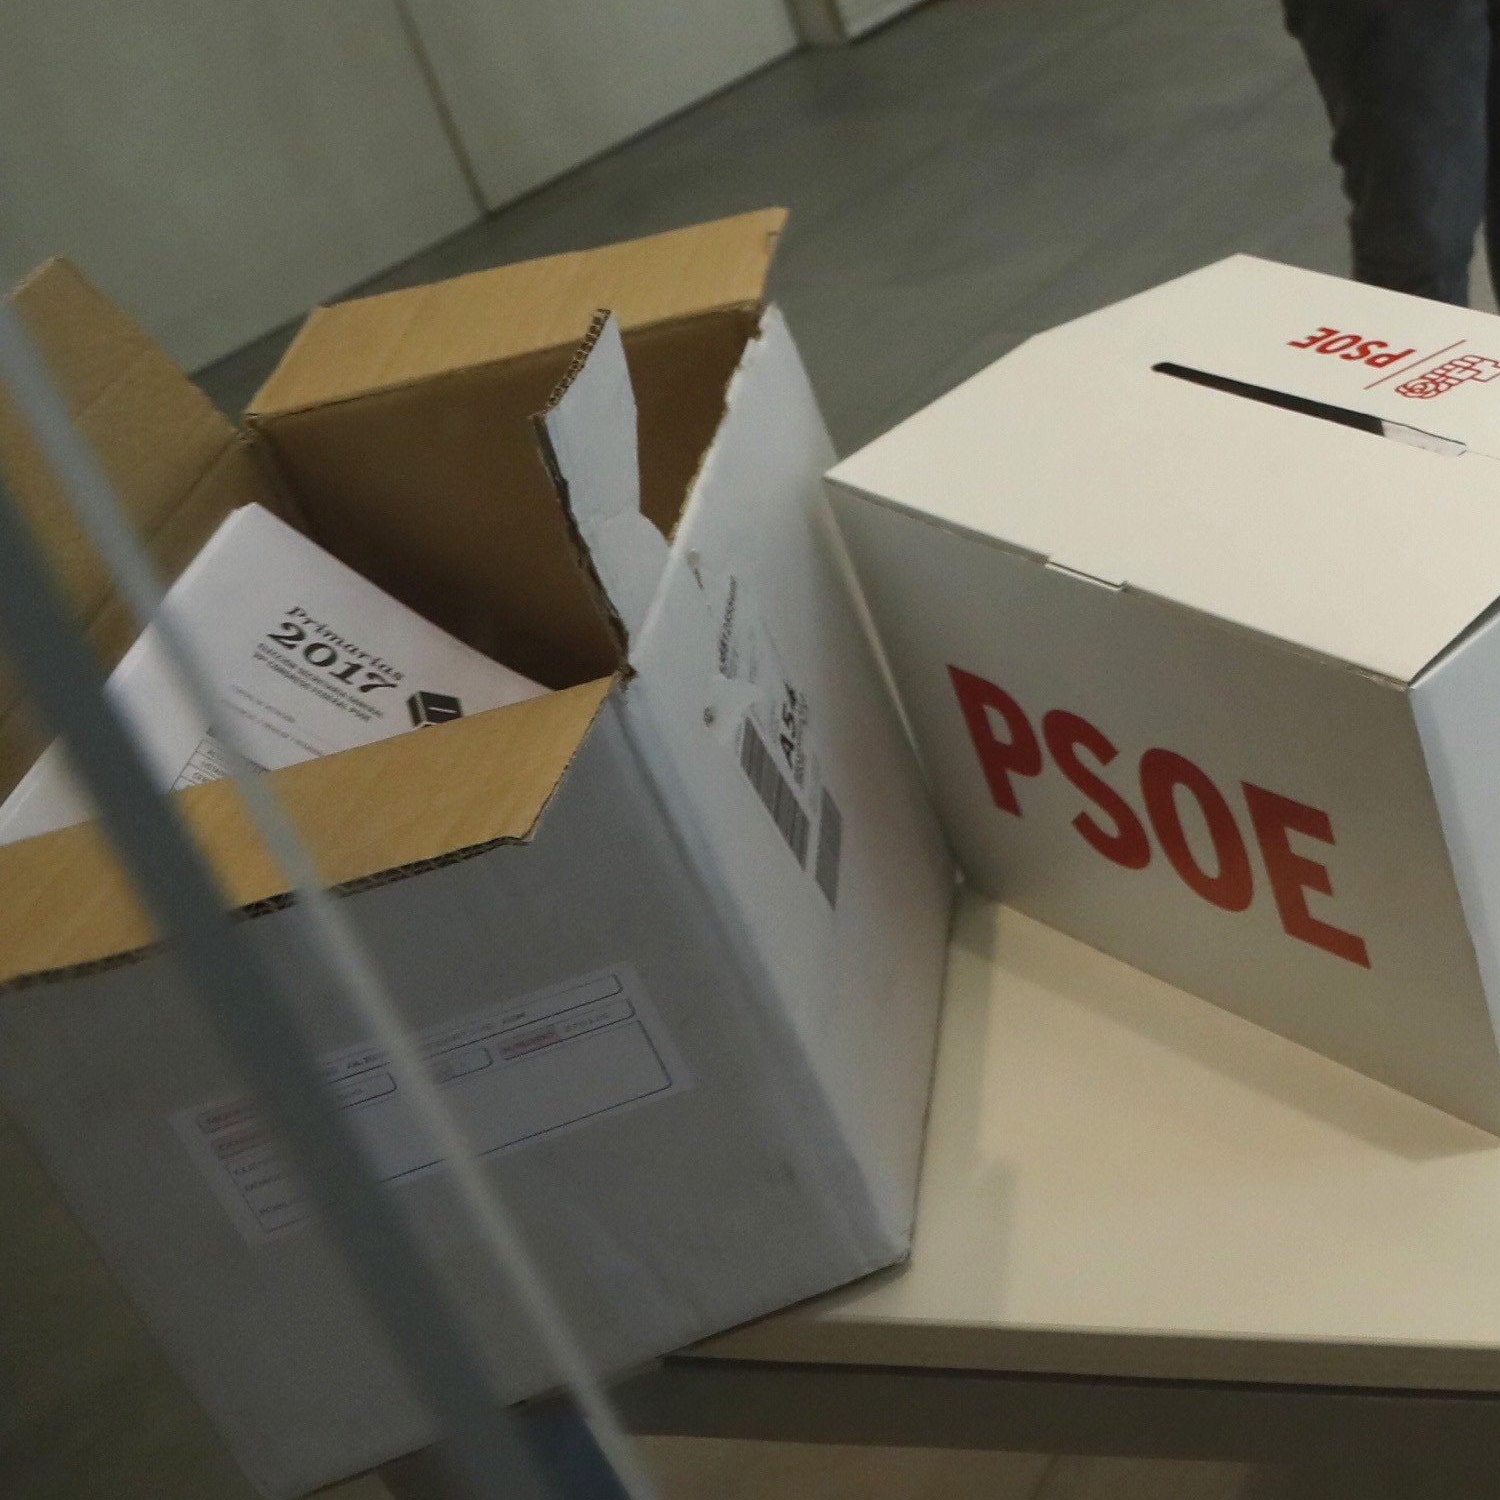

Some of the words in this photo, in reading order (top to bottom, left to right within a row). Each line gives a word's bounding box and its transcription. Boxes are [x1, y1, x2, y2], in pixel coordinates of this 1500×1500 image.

[1287, 326, 1416, 368] PSOE
[267, 622, 398, 693] 2017
[286, 606, 404, 681] Primarias
[947, 664, 1371, 969] PSOE
